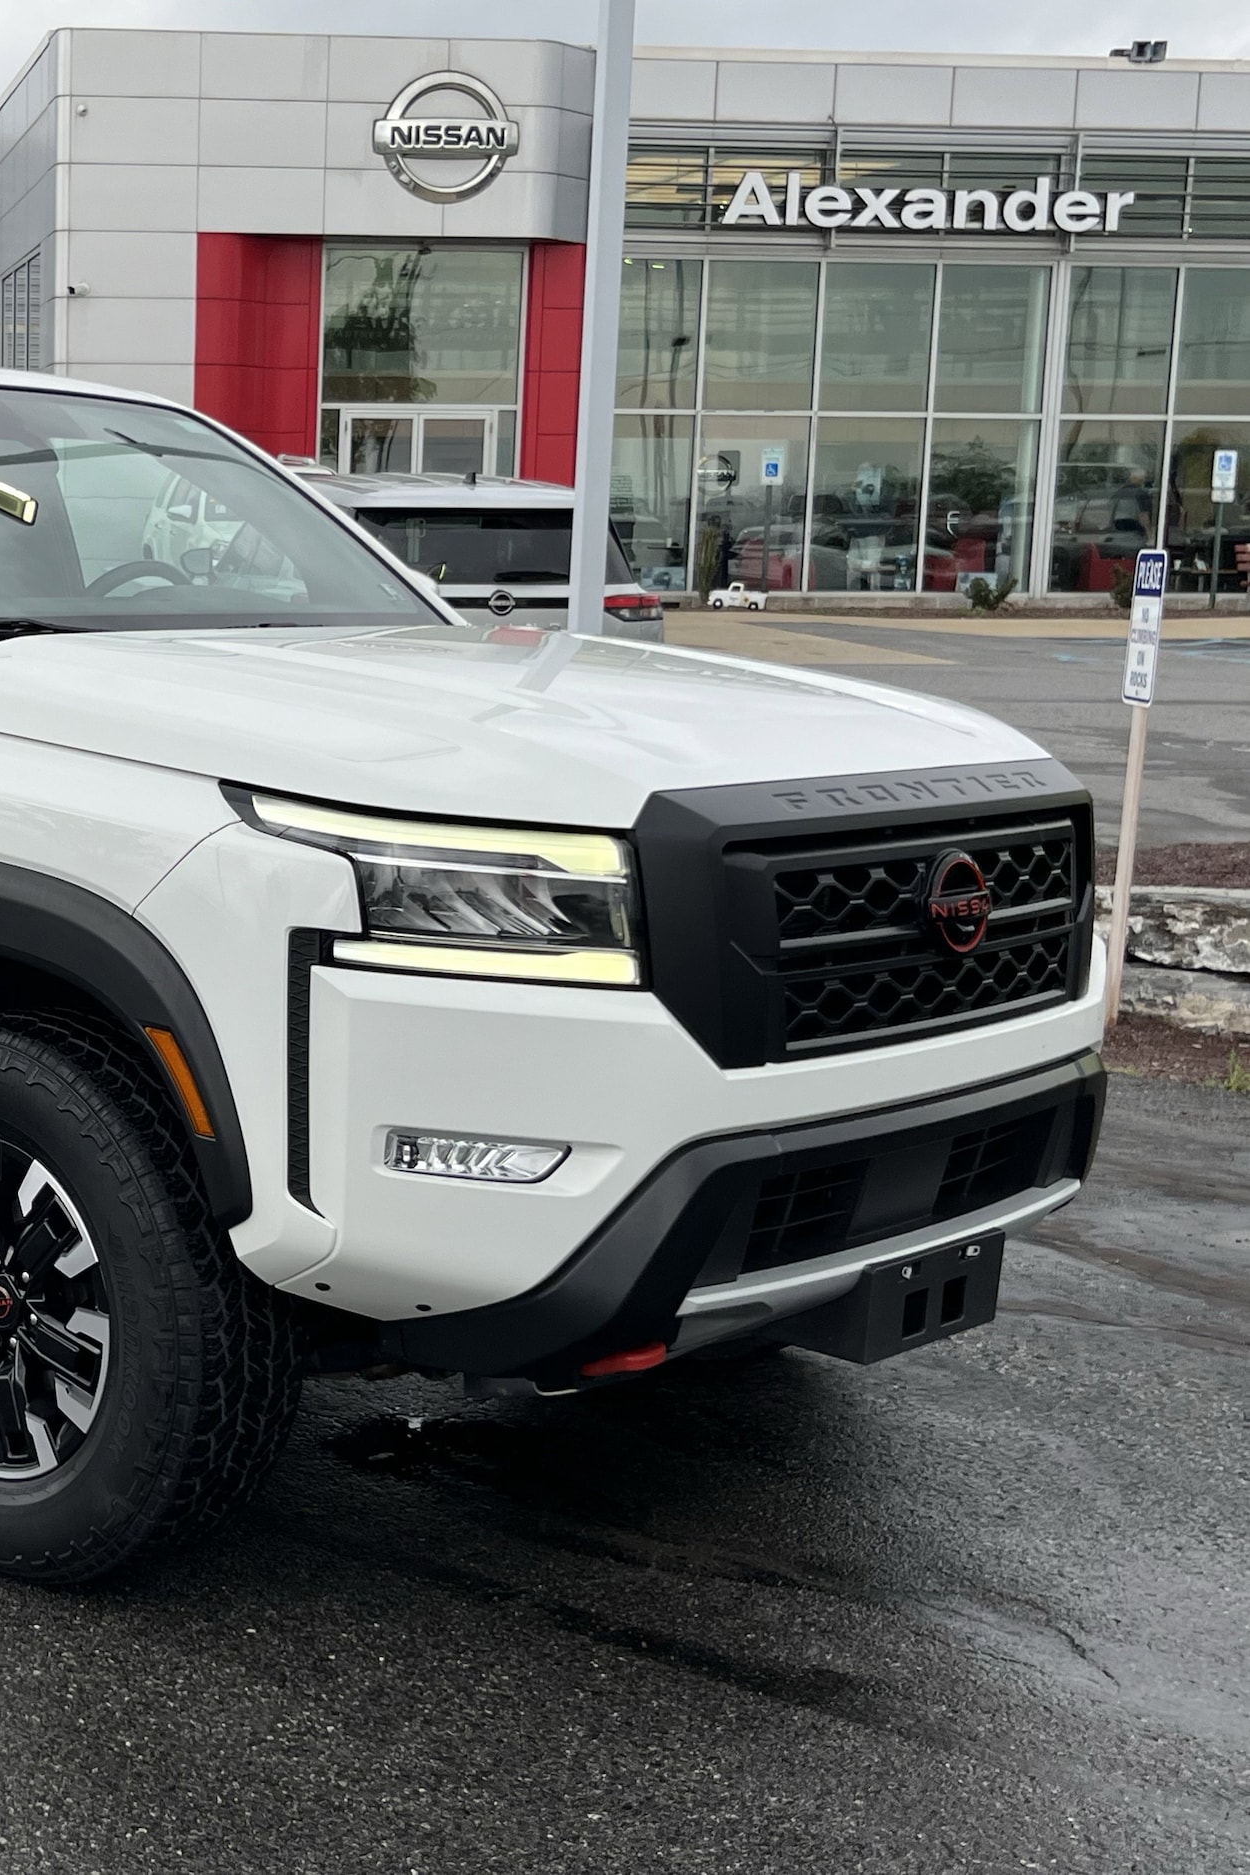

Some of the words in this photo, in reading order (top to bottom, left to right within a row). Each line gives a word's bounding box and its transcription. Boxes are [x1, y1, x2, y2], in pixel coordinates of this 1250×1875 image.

[390, 125, 507, 148] NISSAN
[722, 171, 1135, 232] Alexander
[1137, 559, 1163, 590] PLEASE
[1129, 671, 1147, 689] ROCKS
[772, 771, 1047, 810] FRONTIER
[931, 897, 989, 918] NISS
